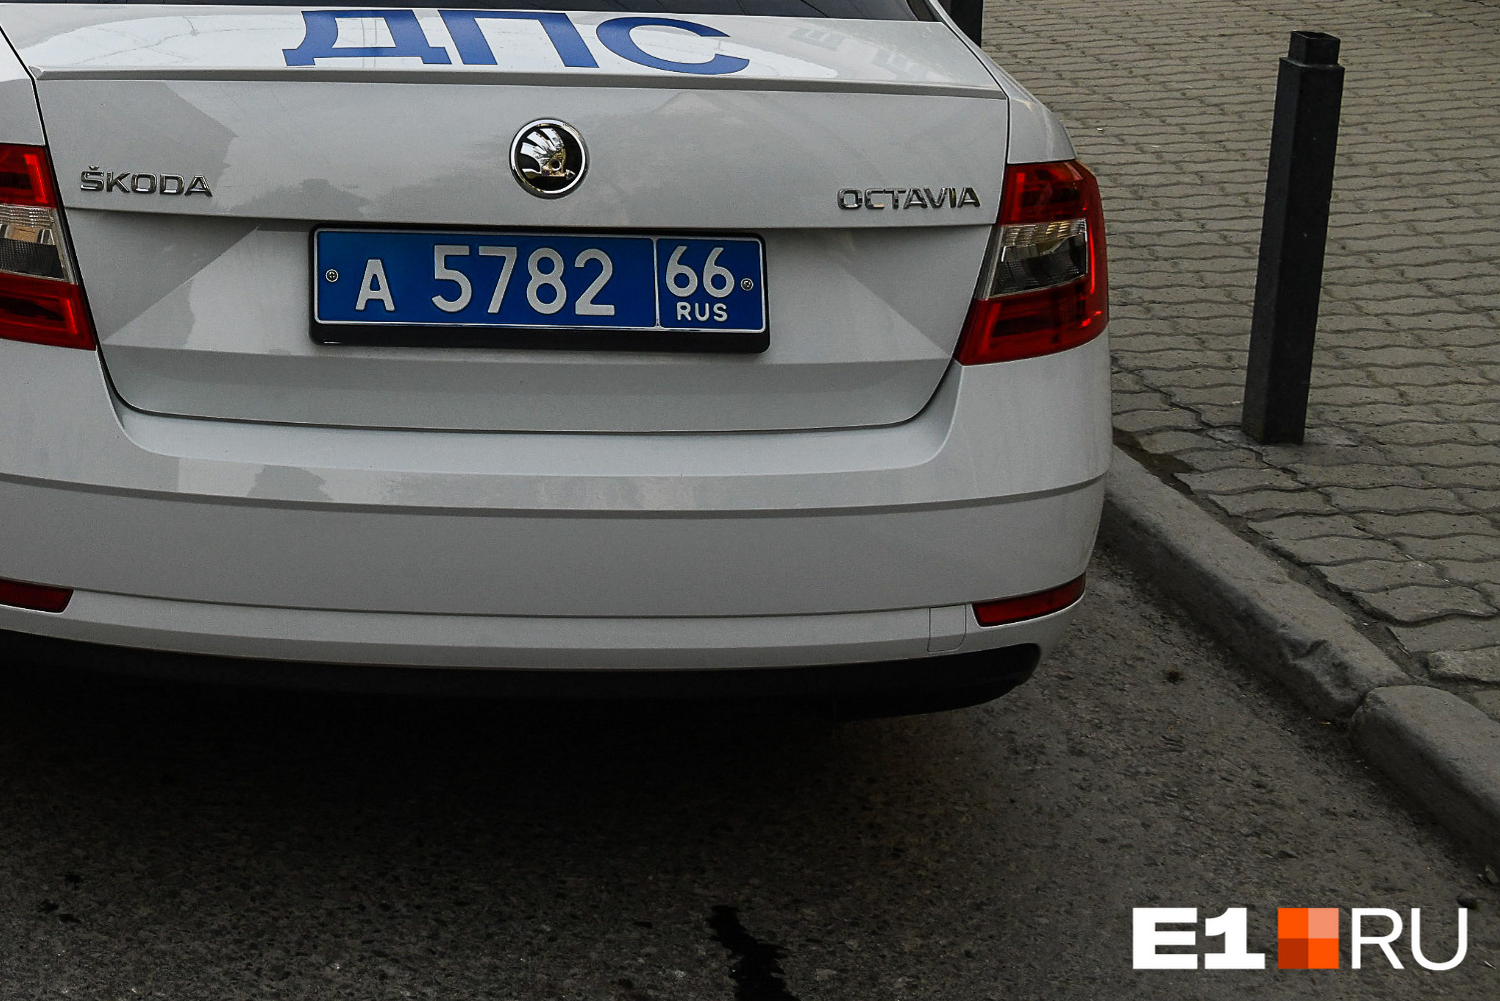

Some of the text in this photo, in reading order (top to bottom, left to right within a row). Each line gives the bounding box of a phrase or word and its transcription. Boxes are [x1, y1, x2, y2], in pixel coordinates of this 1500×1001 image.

[282, 9, 751, 76] ДПС
[80, 165, 213, 197] ŠKODA
[837, 187, 981, 210] OCTAVIA
[431, 244, 617, 317] 5782
[665, 244, 736, 299] 66
[676, 302, 729, 323] RUS
